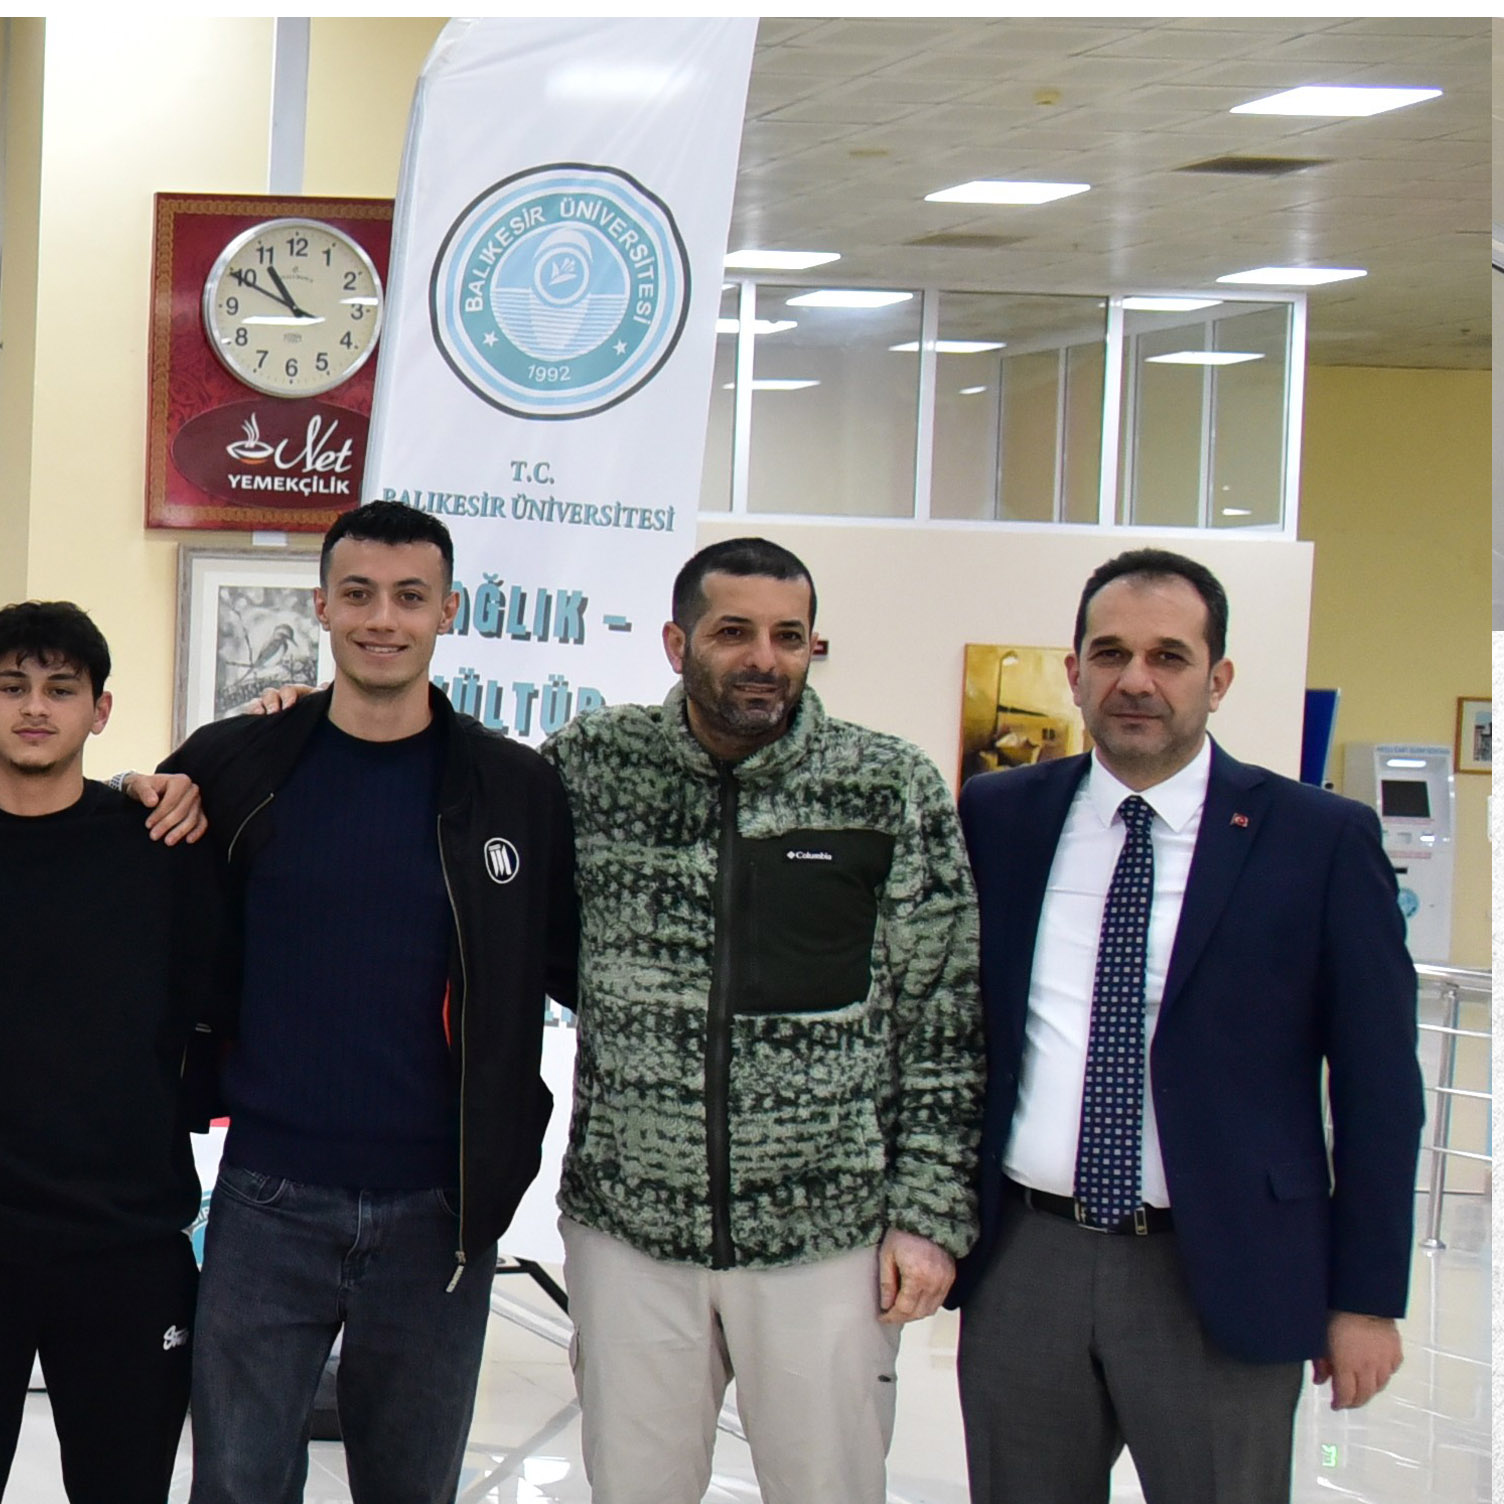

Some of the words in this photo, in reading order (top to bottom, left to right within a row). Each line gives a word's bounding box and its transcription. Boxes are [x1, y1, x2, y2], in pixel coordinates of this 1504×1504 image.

[256, 246, 274, 264] 11
[287, 238, 308, 257] 12
[322, 248, 331, 266] 1
[465, 206, 545, 312] BALIKESİR
[560, 198, 653, 325] ÜNİVERSİTESİ
[234, 268, 256, 287] 10
[343, 272, 356, 290] 2
[226, 297, 238, 315] 9
[351, 303, 364, 320] 3
[235, 328, 248, 346] 8
[340, 331, 353, 349] 4
[256, 350, 269, 368] 7
[285, 358, 298, 377] 6
[316, 353, 328, 371] 5
[528, 365, 571, 382] 1992
[274, 415, 353, 473] Net
[511, 460, 555, 485] T.C.
[228, 474, 350, 495] YEMEKÇİLİK
[511, 493, 675, 533] ÜNİVERSİTESİ
